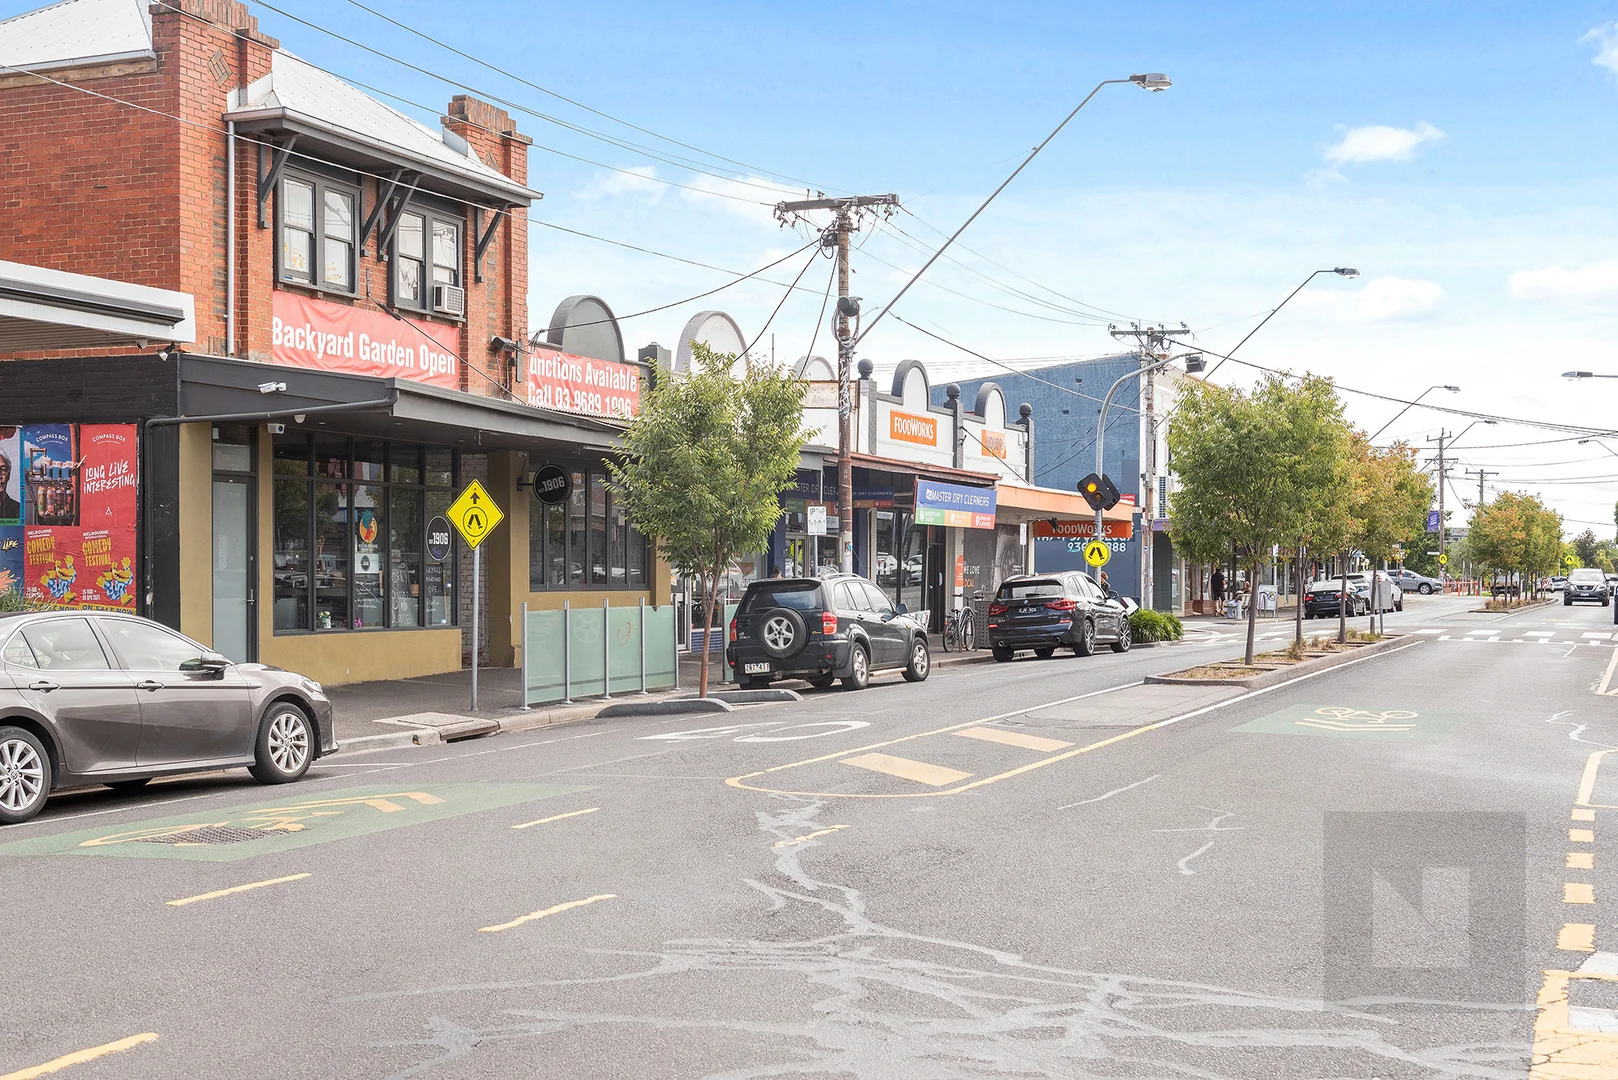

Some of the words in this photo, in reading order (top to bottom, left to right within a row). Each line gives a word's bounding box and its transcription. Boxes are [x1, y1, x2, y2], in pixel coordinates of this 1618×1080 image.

[272, 316, 354, 359] Backyard
[359, 332, 414, 368] Garden
[419, 344, 455, 376] Open
[529, 356, 583, 383] unctions
[585, 362, 637, 393] Available
[527, 381, 552, 407] Call
[555, 386, 570, 410] 03
[574, 389, 602, 413] 9689
[605, 395, 632, 418] 1906
[894, 416, 934, 440] FOODWORKS
[36, 433, 58, 442] COMPASS
[58, 434, 69, 442] BOX
[92, 433, 115, 442] COMPASS
[115, 434, 126, 442] BOX
[85, 464, 106, 482] LONG
[931, 489, 951, 503] MASTER
[952, 493, 964, 504] DRY
[964, 494, 990, 507] CLEANERS
[1052, 524, 1112, 534] OODWOKS
[26, 536, 55, 554] COMEDY
[82, 537, 111, 556] COMEDY
[433, 532, 448, 545] 1906
[1067, 541, 1085, 552] 936
[30, 552, 55, 565] FESTIVAL
[85, 553, 112, 567] FESTIVAL
